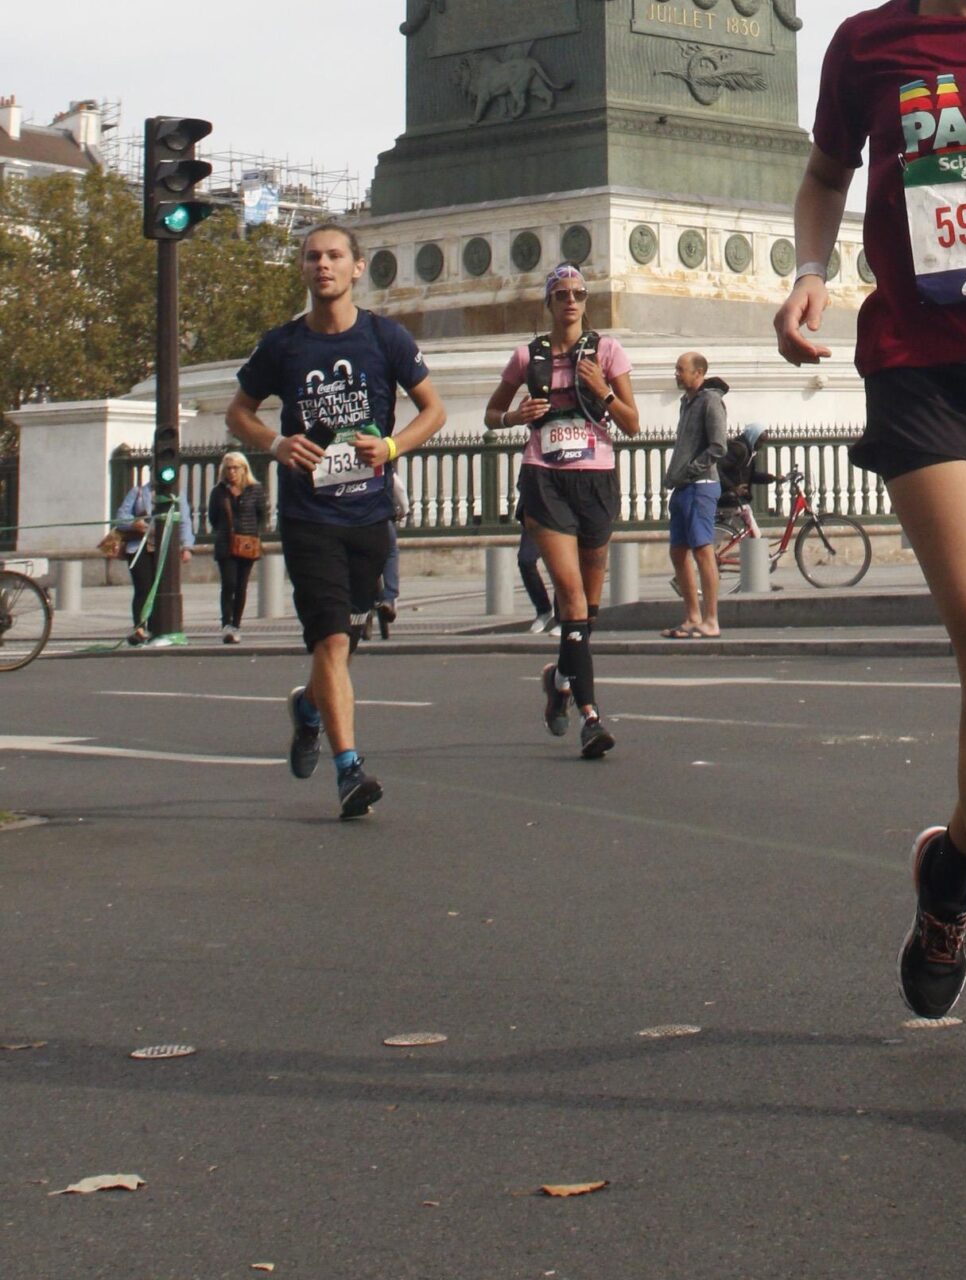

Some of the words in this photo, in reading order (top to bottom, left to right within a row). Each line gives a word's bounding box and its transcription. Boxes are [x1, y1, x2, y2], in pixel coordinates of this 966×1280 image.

[645, 3, 717, 30] JUILLET
[726, 15, 760, 37] 1830
[297, 389, 368, 411] TRIATHLON
[302, 400, 370, 420] DEAUVILLE
